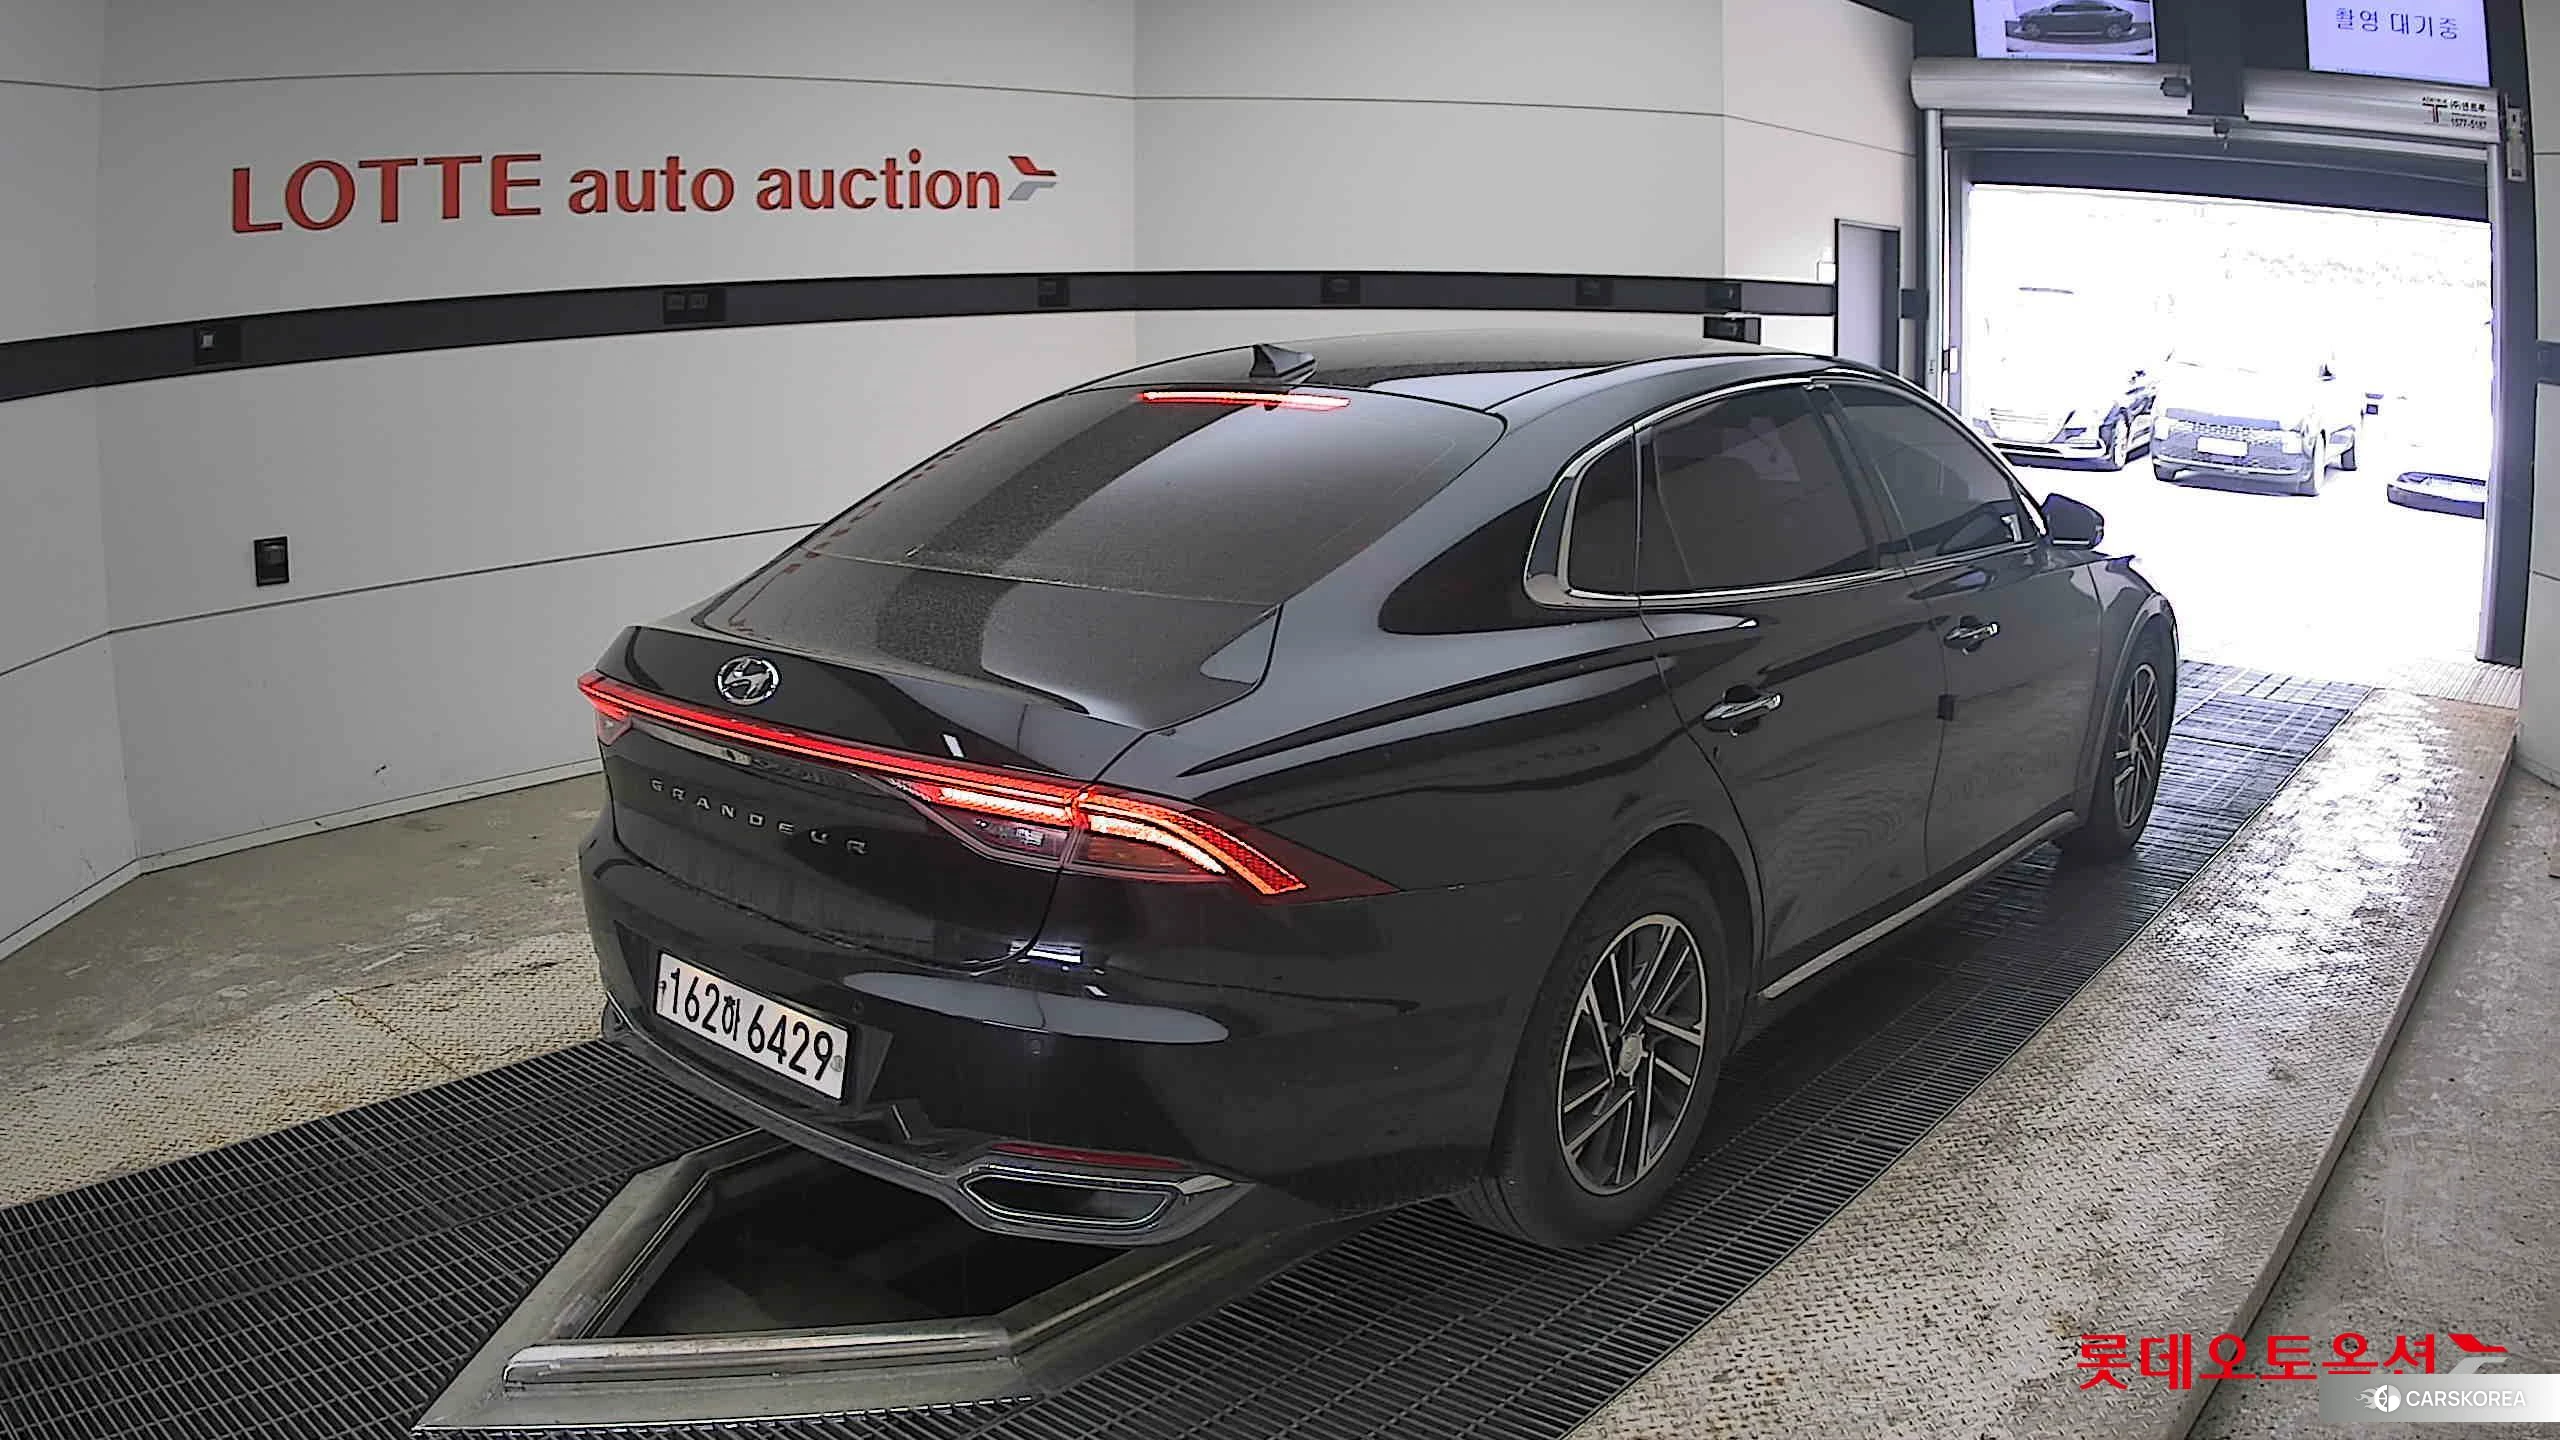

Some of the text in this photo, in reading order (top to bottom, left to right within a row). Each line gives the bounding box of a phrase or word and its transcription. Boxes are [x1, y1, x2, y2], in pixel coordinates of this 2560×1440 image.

[2335, 7, 2459, 41] 촬영 대기중
[232, 149, 1002, 234] LOTTE auto auction
[651, 777, 868, 855] GRANDEUR
[747, 1004, 834, 1082] 6429
